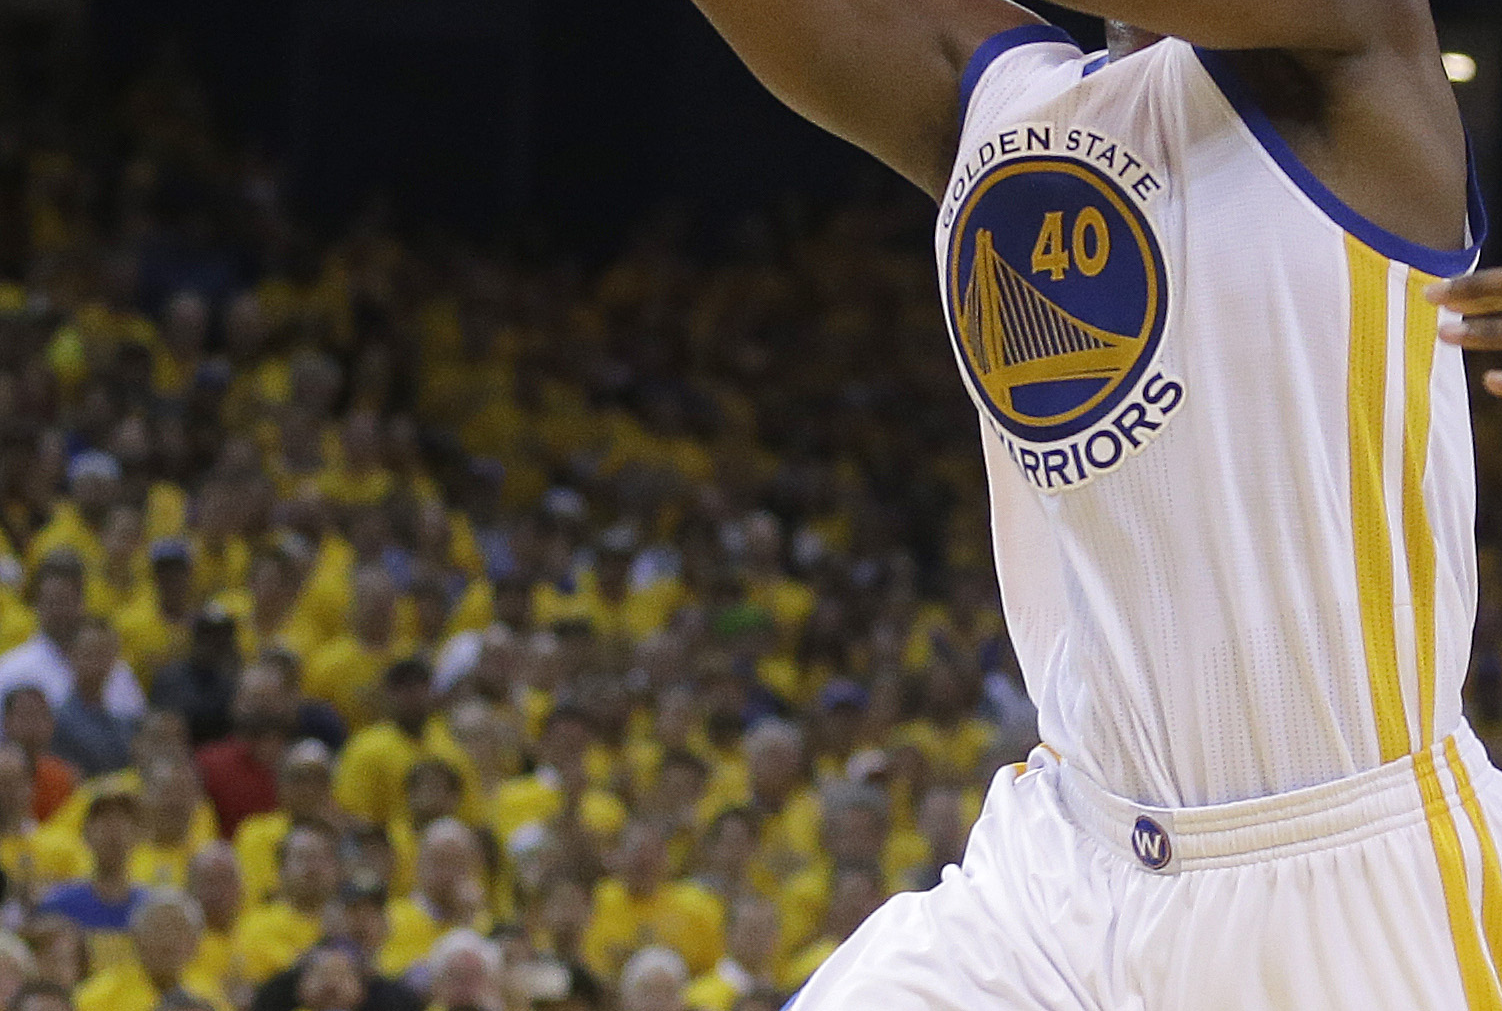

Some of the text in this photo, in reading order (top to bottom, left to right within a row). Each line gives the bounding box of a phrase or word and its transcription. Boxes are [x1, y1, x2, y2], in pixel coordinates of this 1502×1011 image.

[943, 127, 1161, 229] GOLDEN STATE
[1031, 205, 1111, 281] 40
[1134, 830, 1162, 859] W
